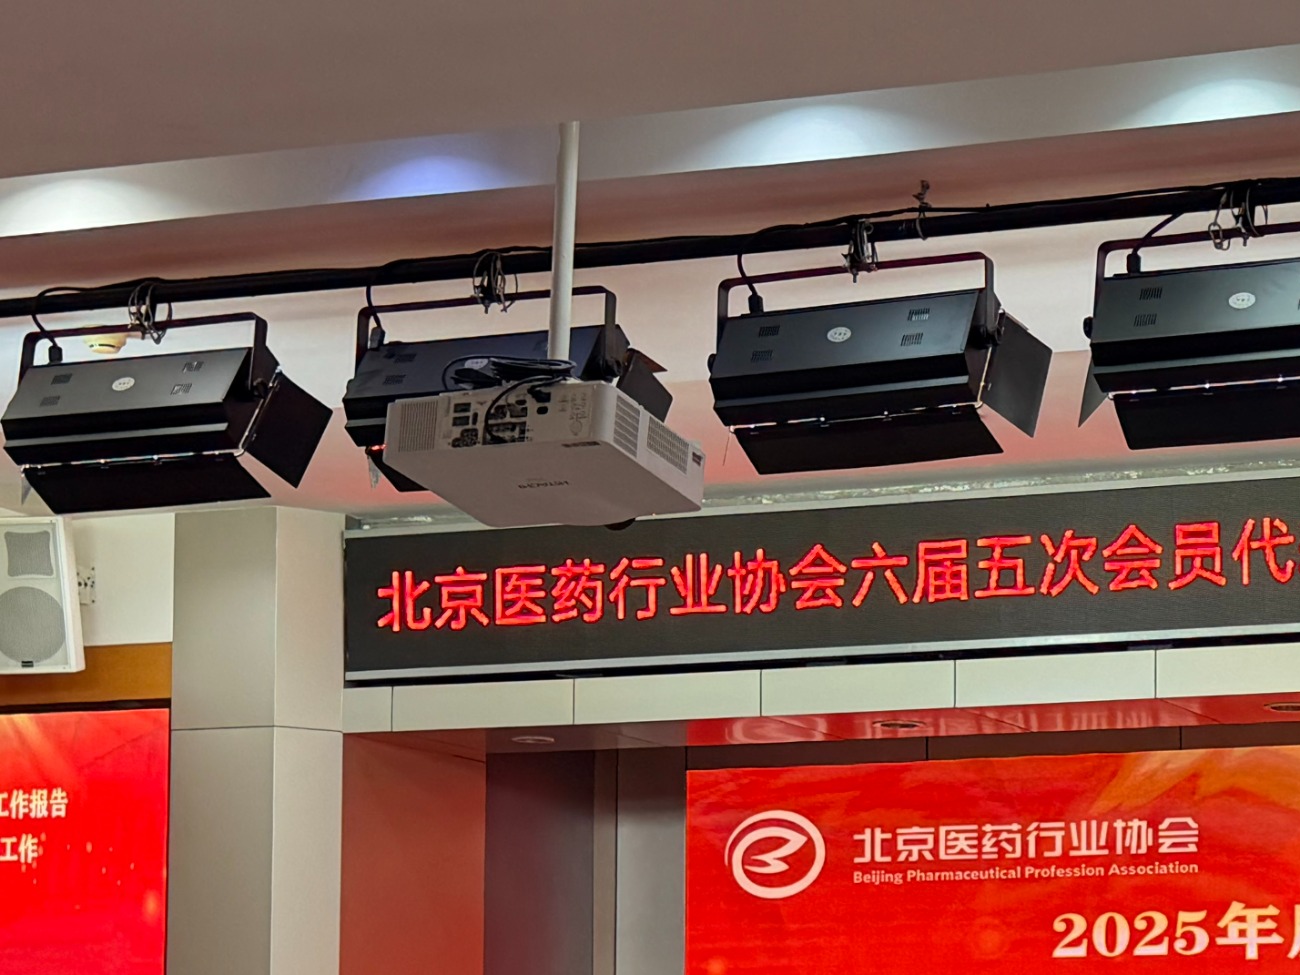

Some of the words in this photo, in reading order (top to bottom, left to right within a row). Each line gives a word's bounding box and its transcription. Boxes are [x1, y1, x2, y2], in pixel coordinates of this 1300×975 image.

[853, 816, 1199, 864] 北京医药行业协会
[853, 870, 904, 885] Beijing
[906, 866, 1021, 882] Pharmaceutical
[1025, 864, 1104, 879] Profession
[1108, 861, 1199, 876] Association
